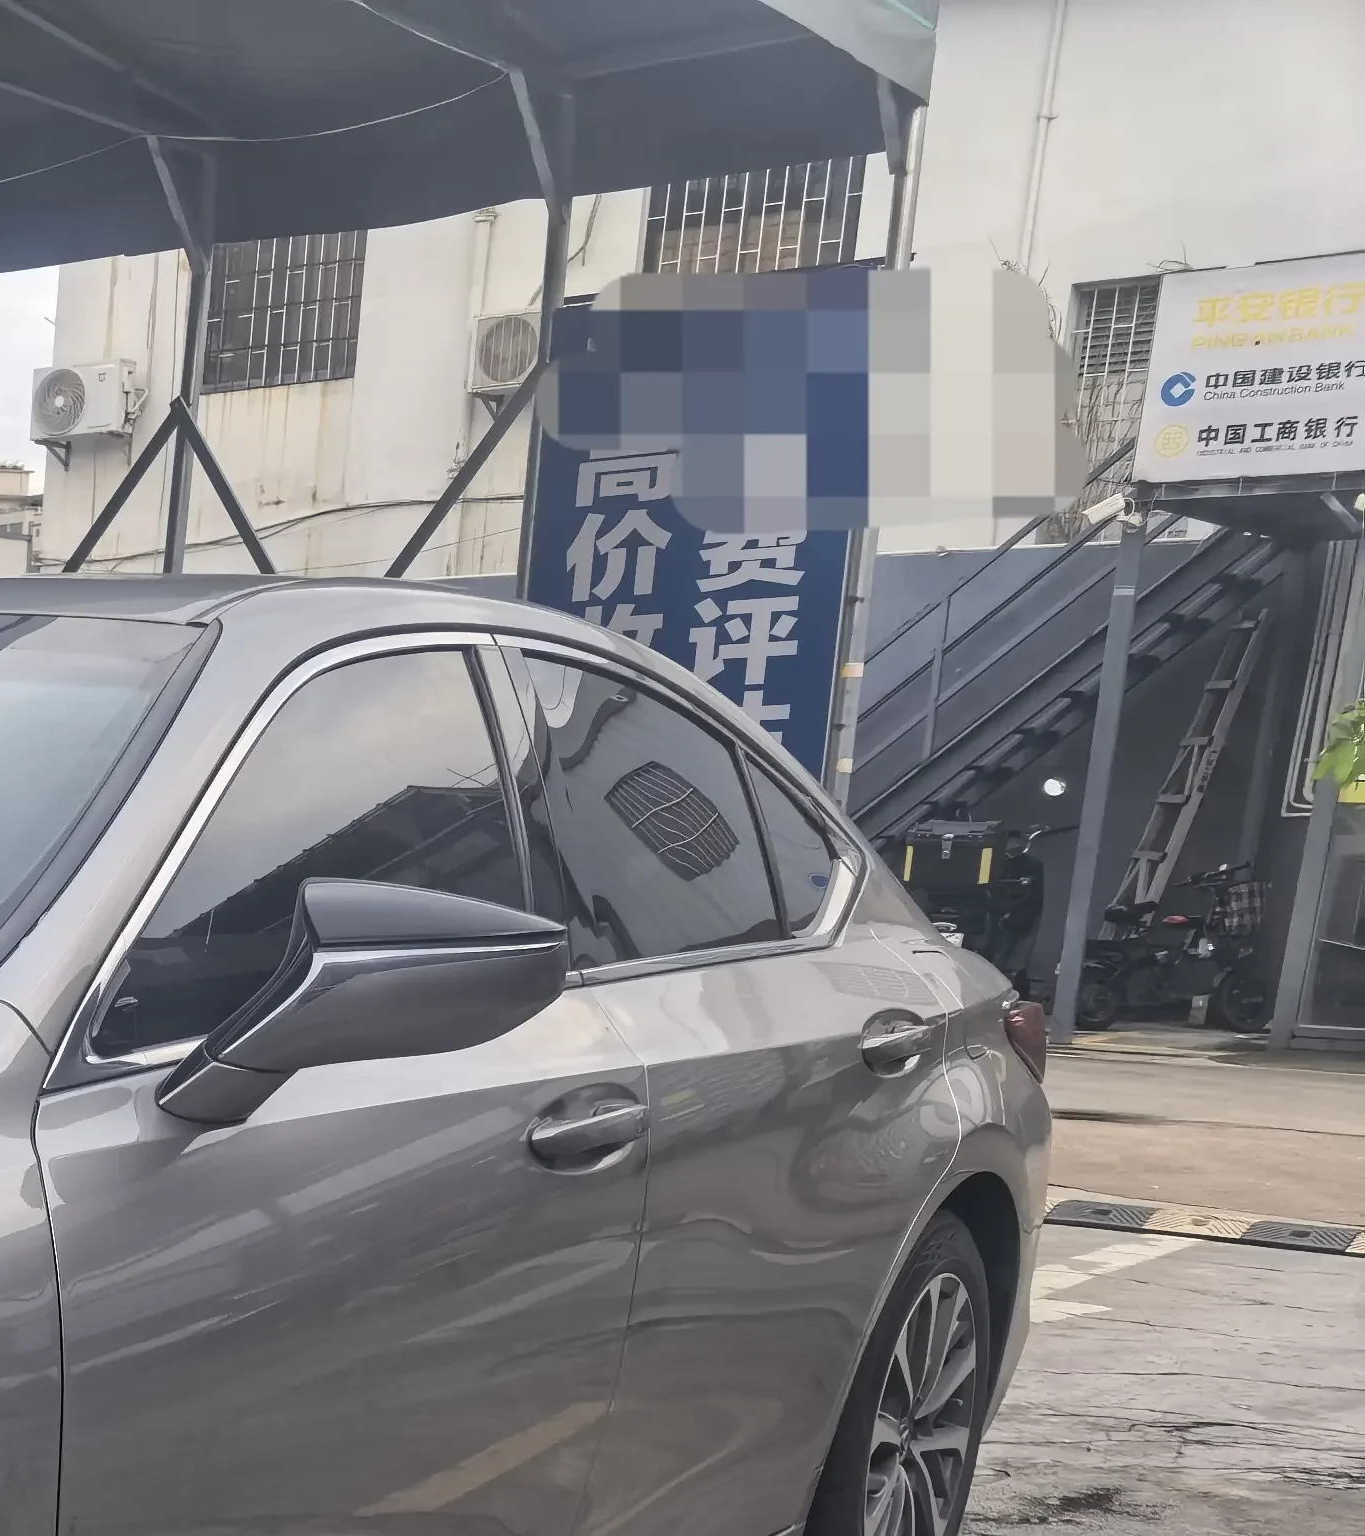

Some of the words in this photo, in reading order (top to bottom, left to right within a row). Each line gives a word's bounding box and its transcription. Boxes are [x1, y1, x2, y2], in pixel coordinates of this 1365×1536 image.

[1192, 281, 1365, 327] 平安银行
[1205, 360, 1365, 390] 中国建设银行
[1203, 389, 1236, 401] China
[1239, 384, 1311, 399] Construction
[1314, 381, 1345, 393] Bank
[1197, 415, 1358, 448] 中国工商银行
